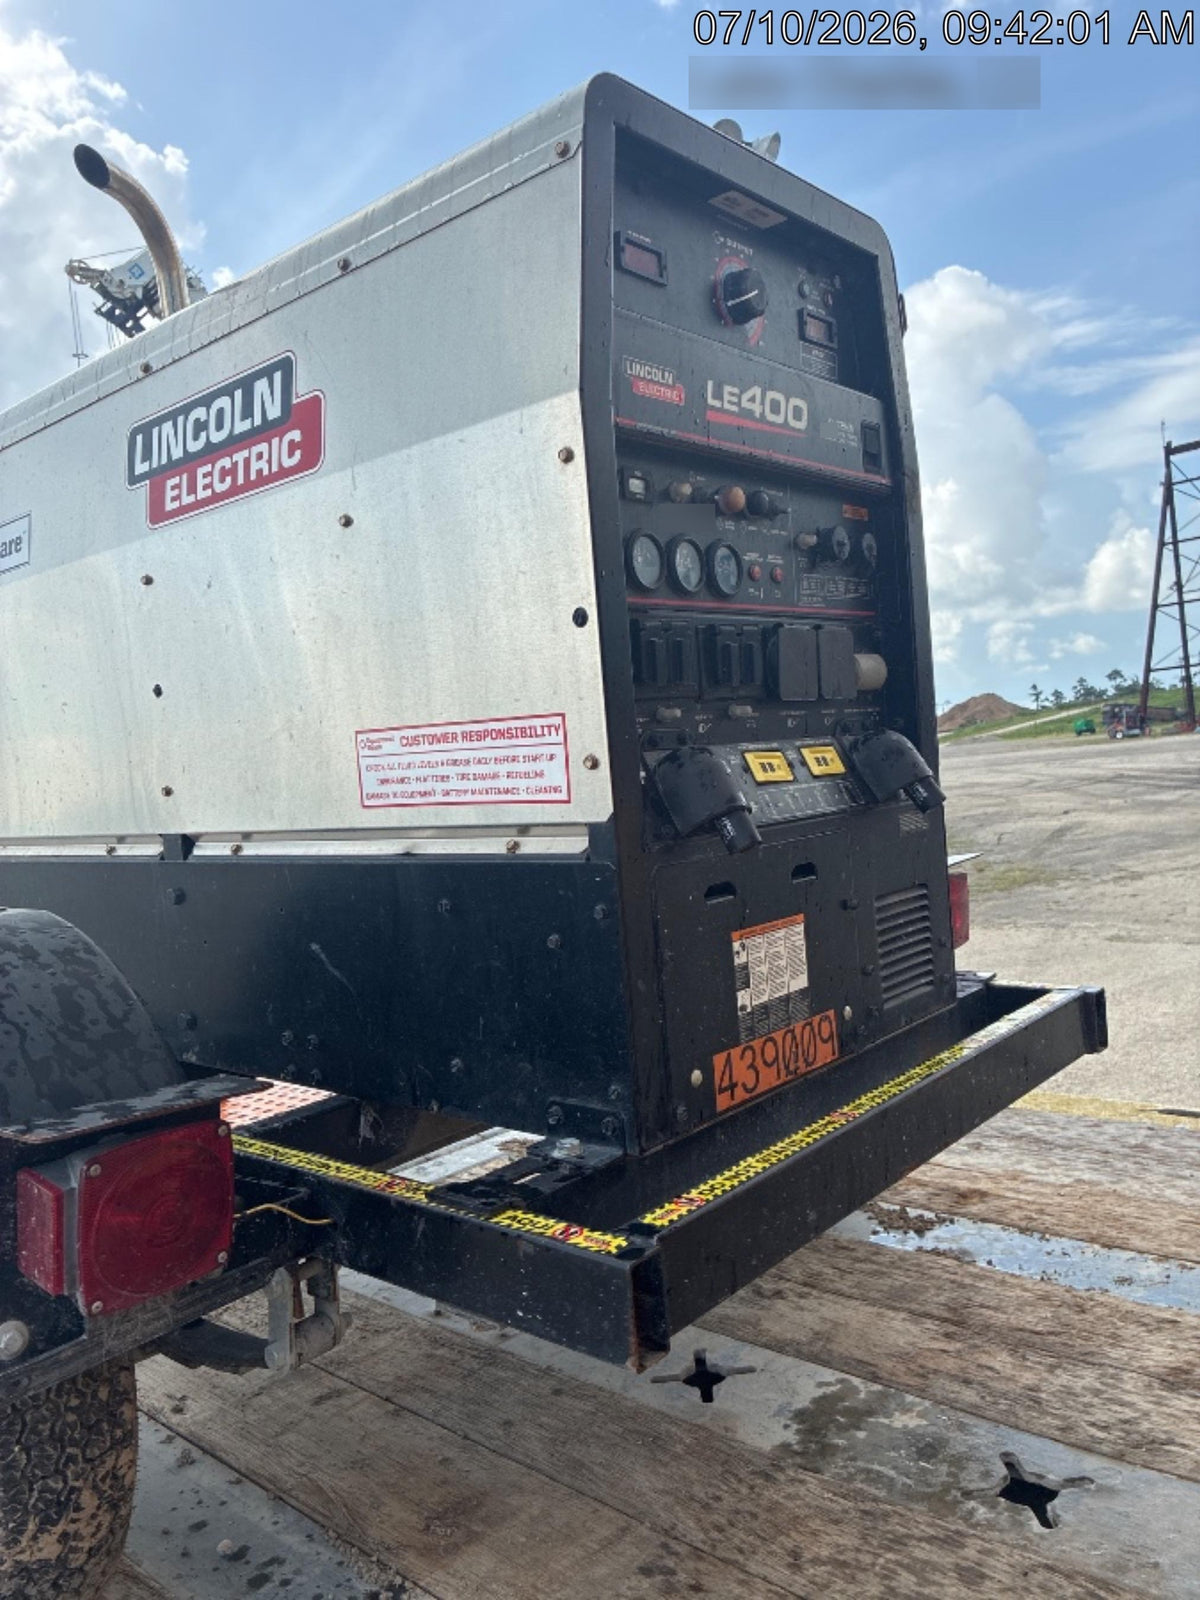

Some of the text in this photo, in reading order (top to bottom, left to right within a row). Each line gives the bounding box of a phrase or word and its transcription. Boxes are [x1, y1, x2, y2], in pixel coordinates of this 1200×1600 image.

[625, 360, 674, 386] LINCOLN
[133, 370, 283, 477] LINCOLN
[706, 379, 809, 431] LE400
[163, 429, 303, 513] ELECTRIC
[400, 731, 459, 748] CUSTOMER
[461, 723, 562, 743] RESPONSIBILITY
